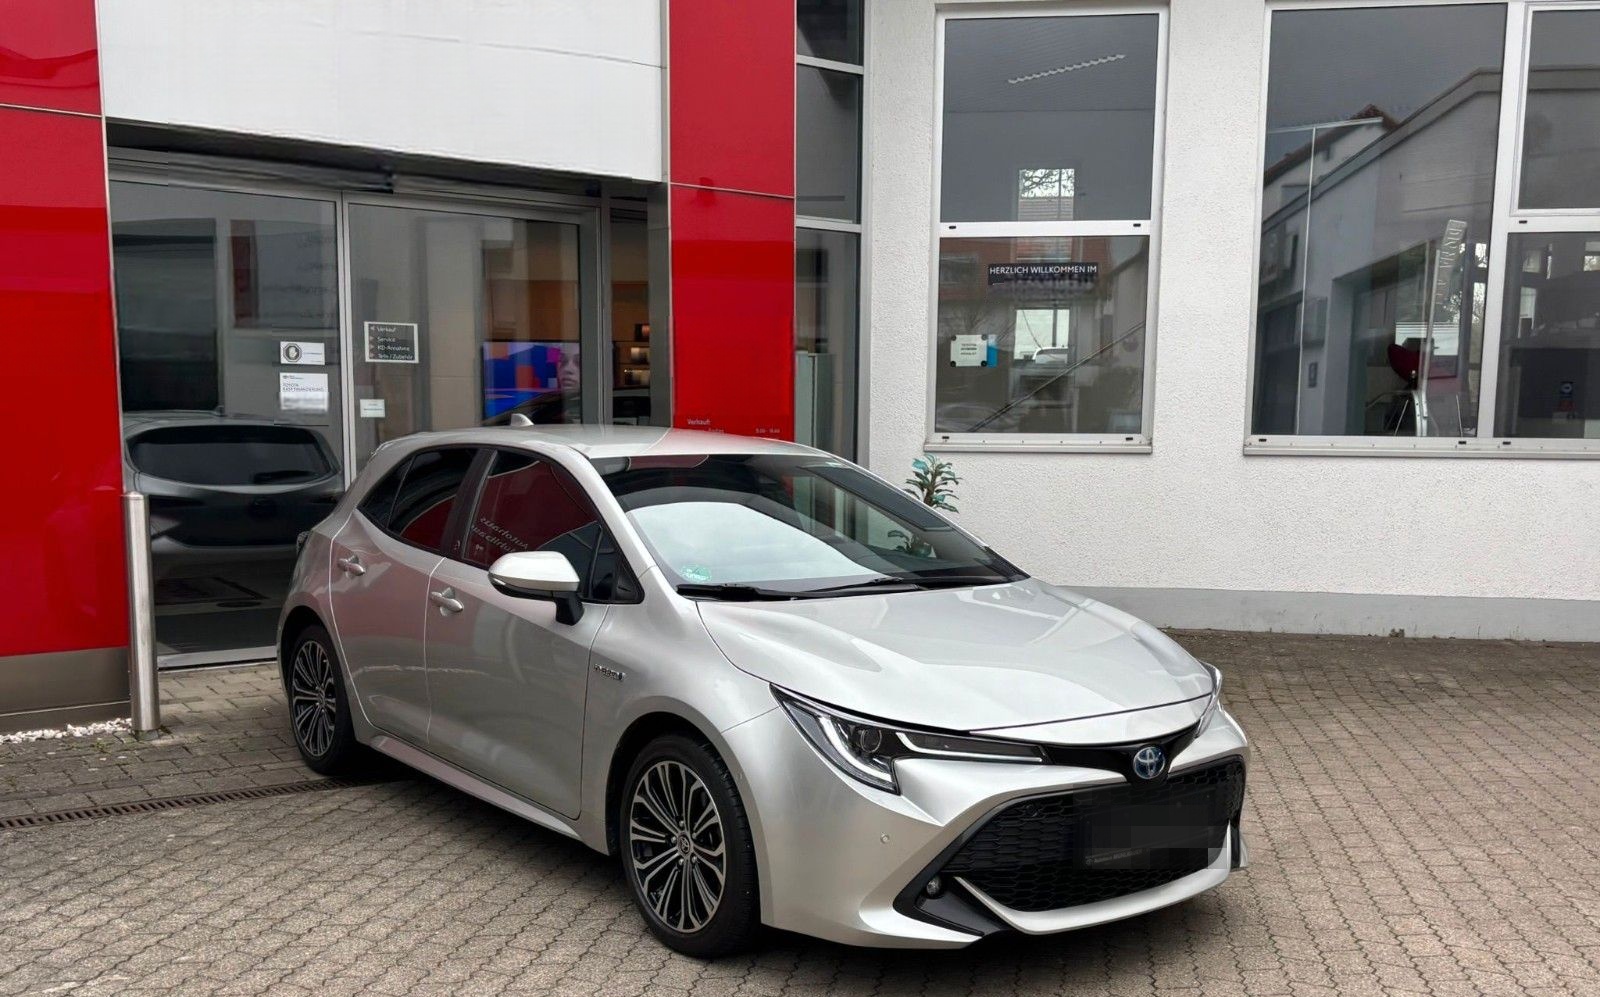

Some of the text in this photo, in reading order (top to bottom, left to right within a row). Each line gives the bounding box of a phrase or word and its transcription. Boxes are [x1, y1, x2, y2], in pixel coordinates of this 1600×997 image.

[989, 265, 1097, 274] HERZLICH WILLKOMMEN IM
